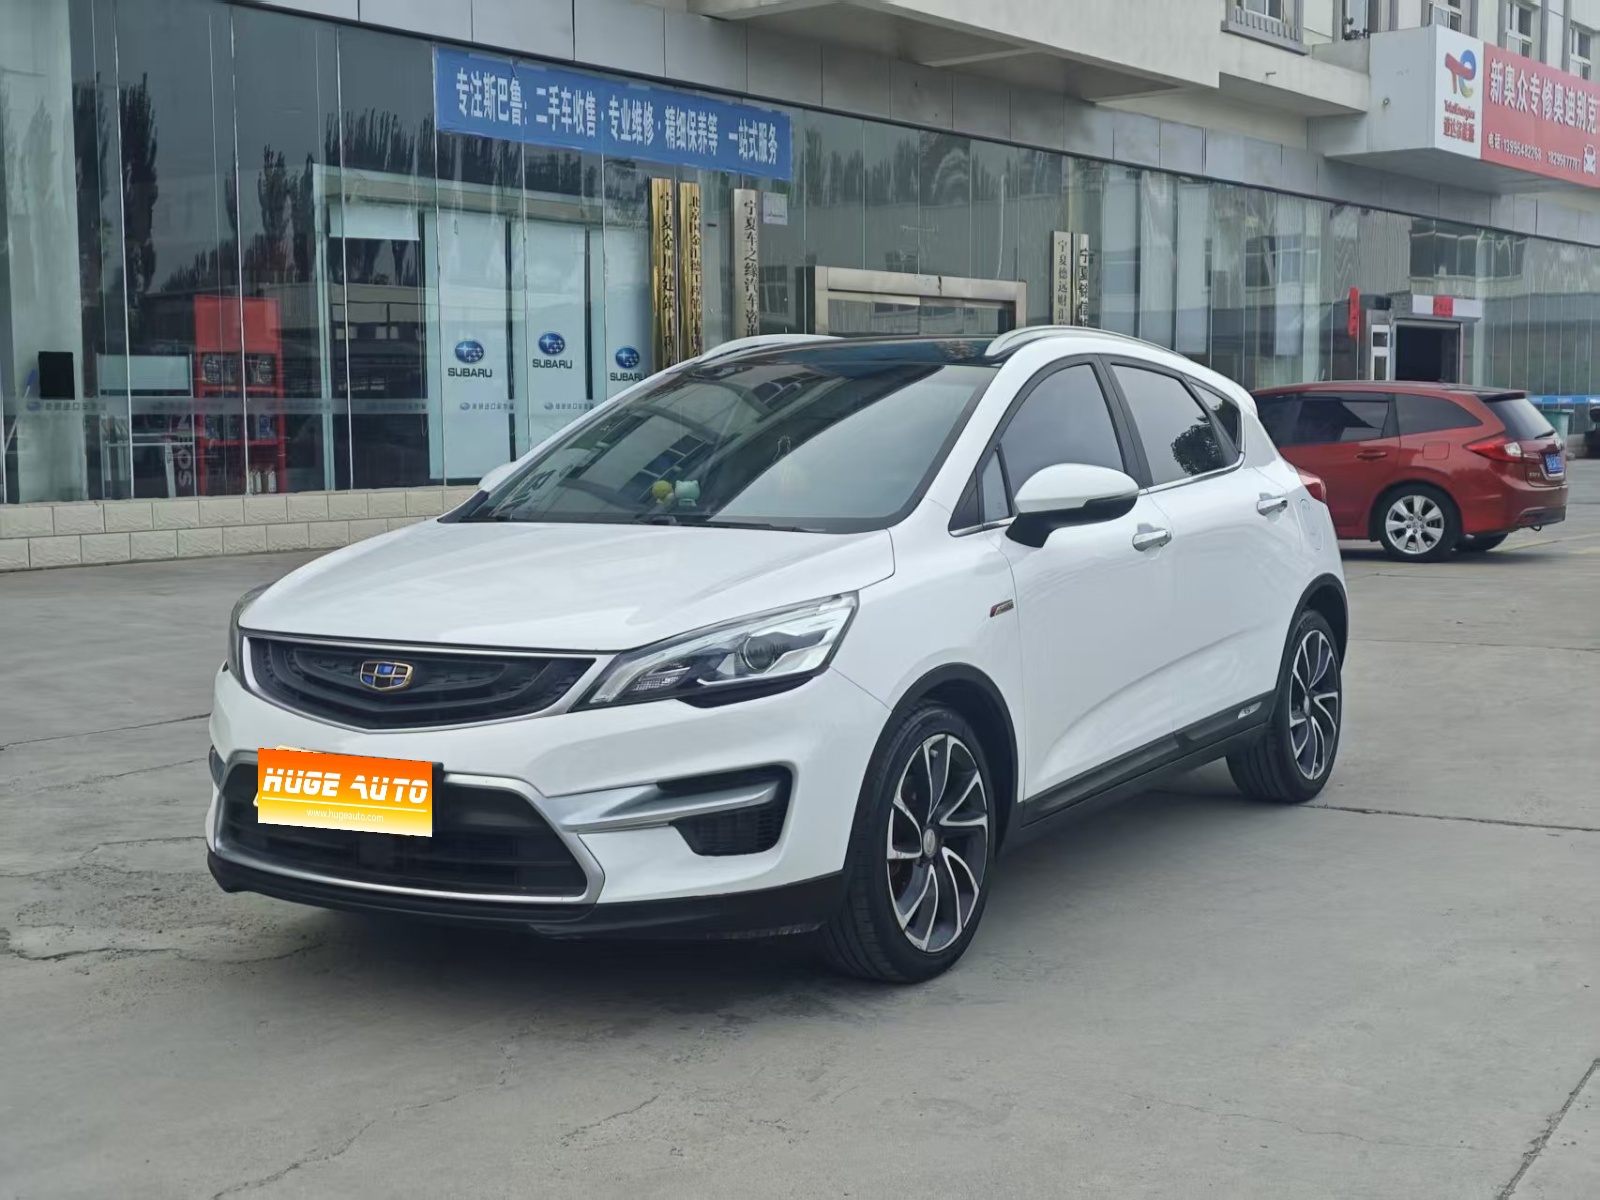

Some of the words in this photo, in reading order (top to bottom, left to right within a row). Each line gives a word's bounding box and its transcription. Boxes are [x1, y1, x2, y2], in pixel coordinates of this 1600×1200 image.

[1490, 58, 1600, 134] 新奥众专修奥迪别克
[728, 118, 778, 165] 一站式服务
[1057, 239, 1068, 325] 宁夏德远财汇
[447, 367, 493, 378] SUBARU
[532, 358, 573, 369] SUBARU
